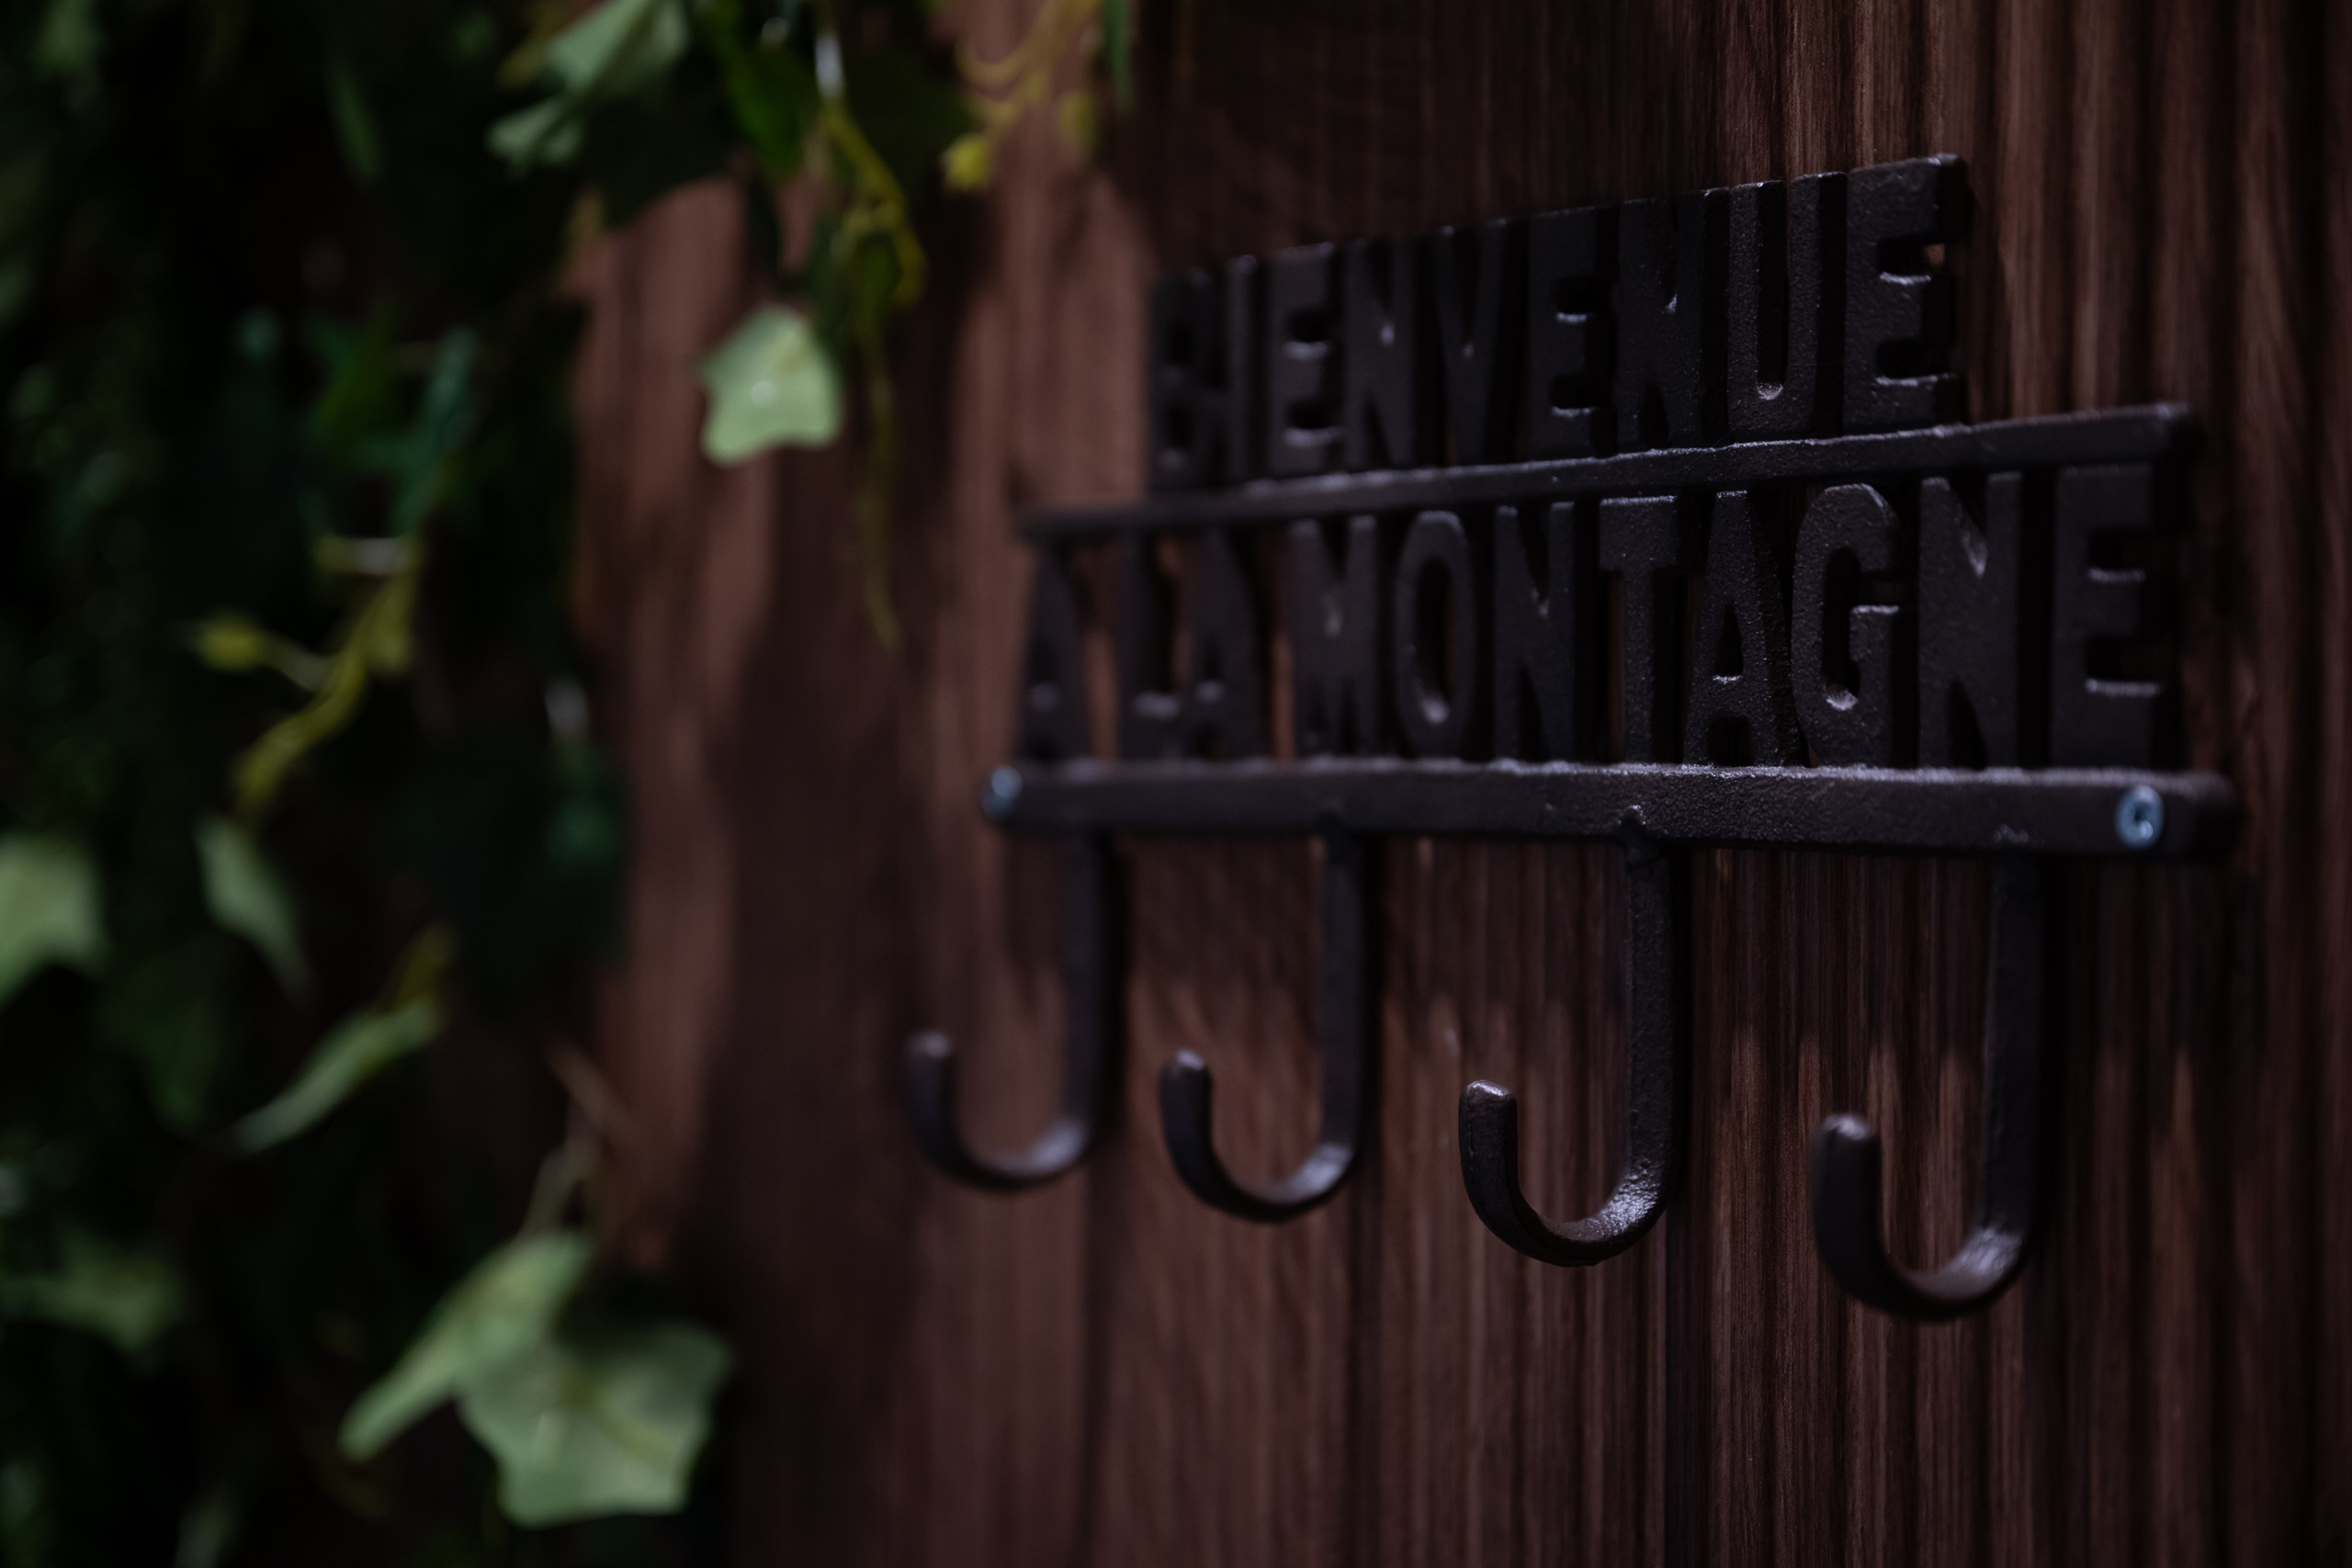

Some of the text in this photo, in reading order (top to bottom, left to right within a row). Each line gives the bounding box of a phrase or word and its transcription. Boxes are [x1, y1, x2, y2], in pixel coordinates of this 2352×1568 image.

[1151, 154, 1961, 487] BIENVENUE
[1016, 462, 2164, 768] A LA MONTAGNE
